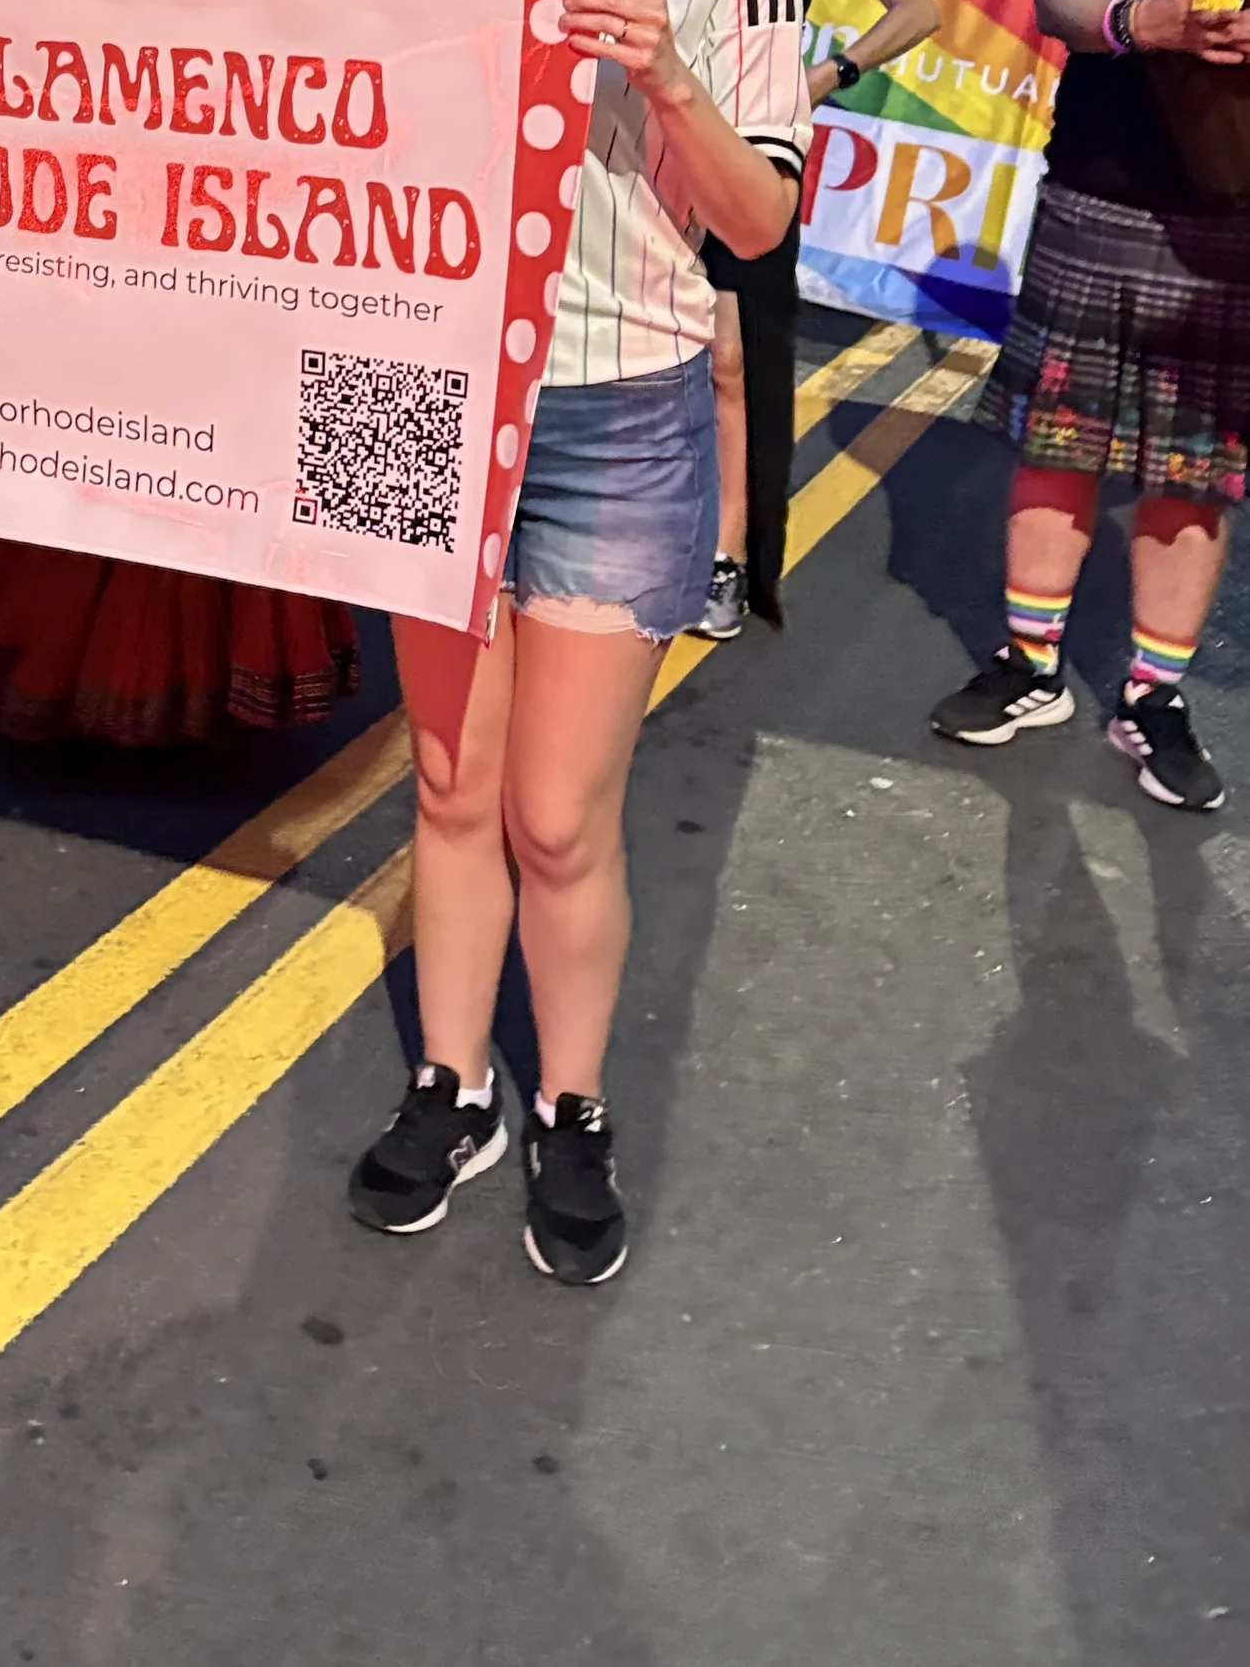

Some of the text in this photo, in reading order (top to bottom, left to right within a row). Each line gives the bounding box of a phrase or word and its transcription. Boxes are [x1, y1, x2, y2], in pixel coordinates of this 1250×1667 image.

[159, 161, 483, 280] ISLAND
[800, 122, 1038, 277] PRI
[123, 264, 178, 293] and
[185, 270, 300, 311] thriving
[308, 285, 444, 324] together
